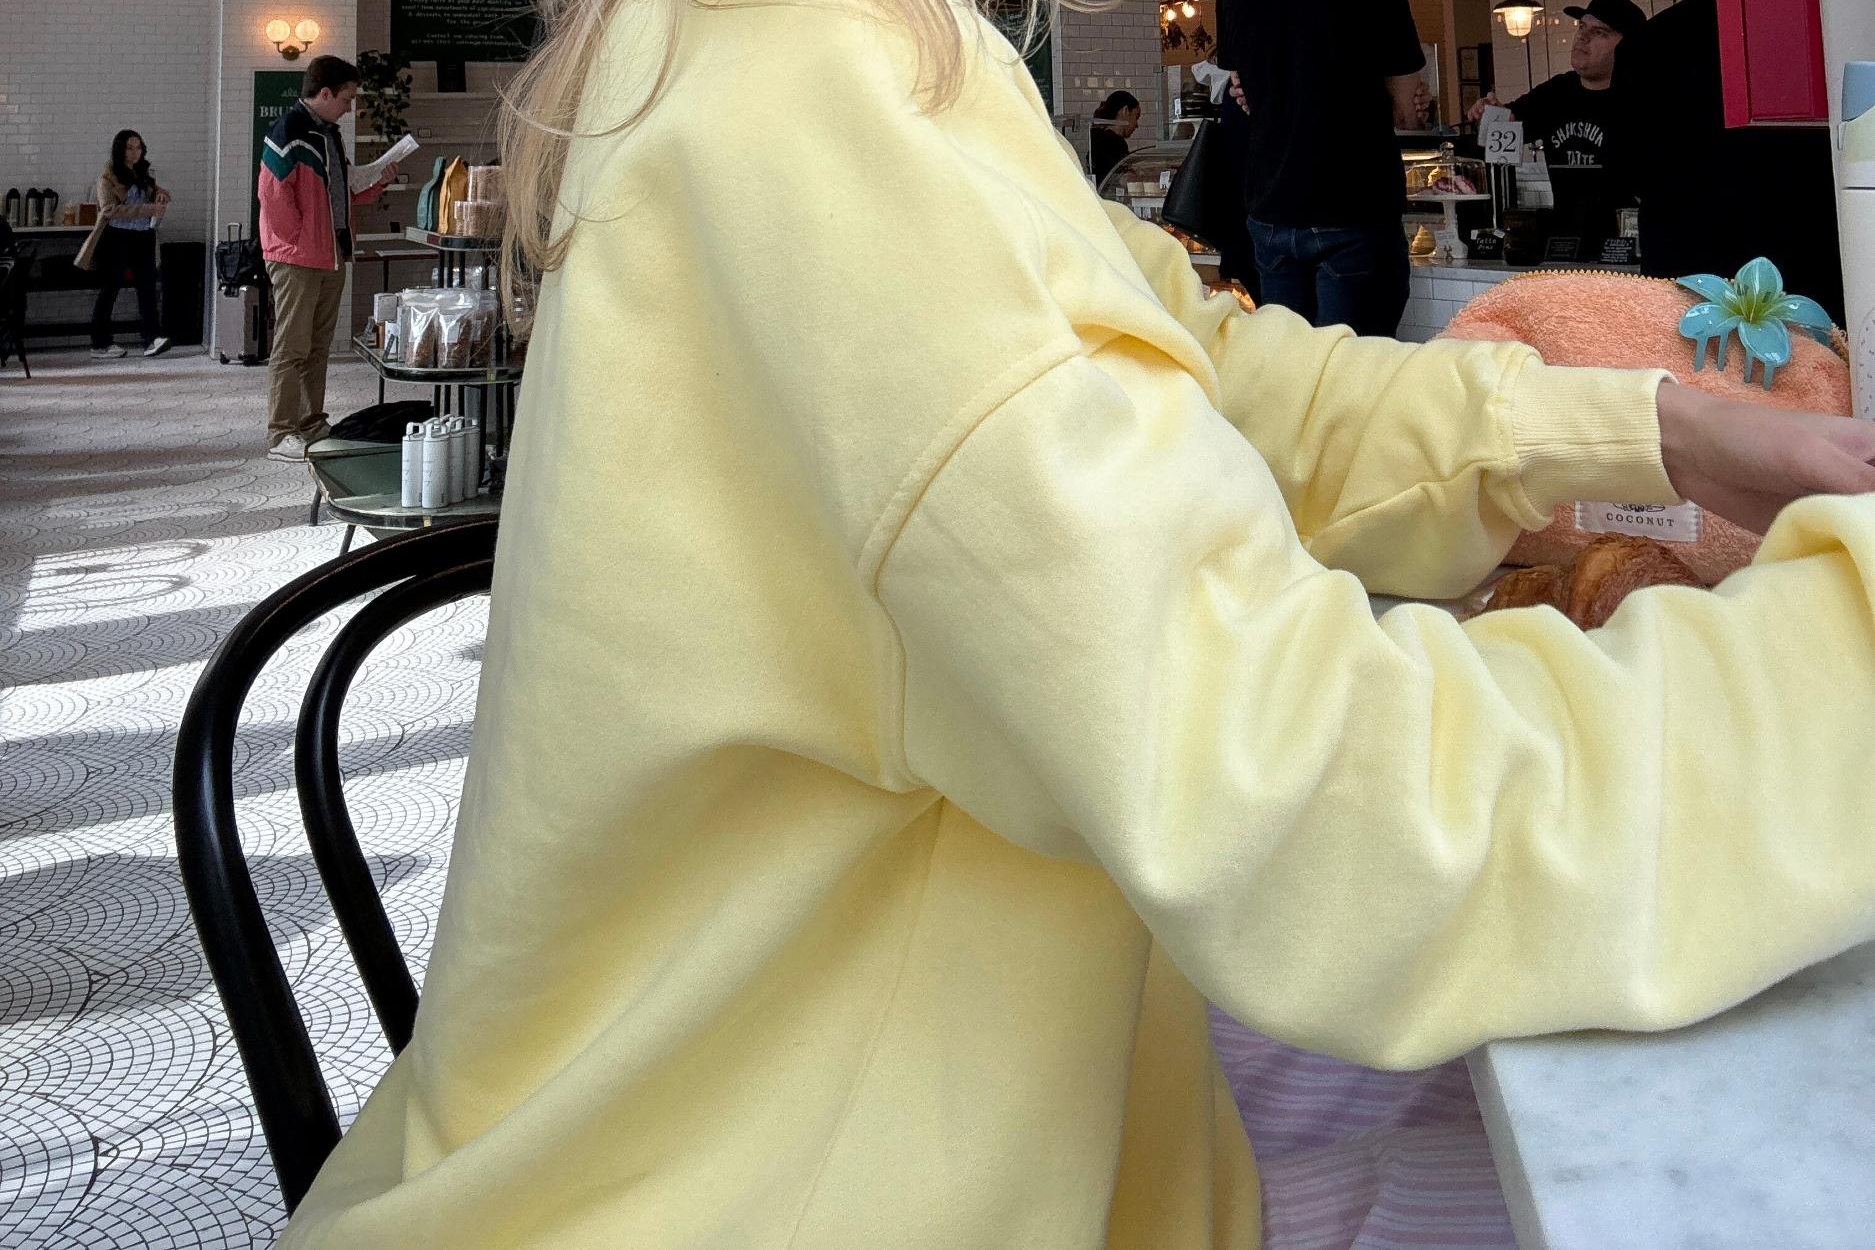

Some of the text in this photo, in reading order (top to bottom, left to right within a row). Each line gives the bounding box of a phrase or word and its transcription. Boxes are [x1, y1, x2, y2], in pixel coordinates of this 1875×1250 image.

[1489, 131, 1516, 152] 32
[1566, 150, 1595, 166] TATTE
[1606, 512, 1675, 528] COCONUT
